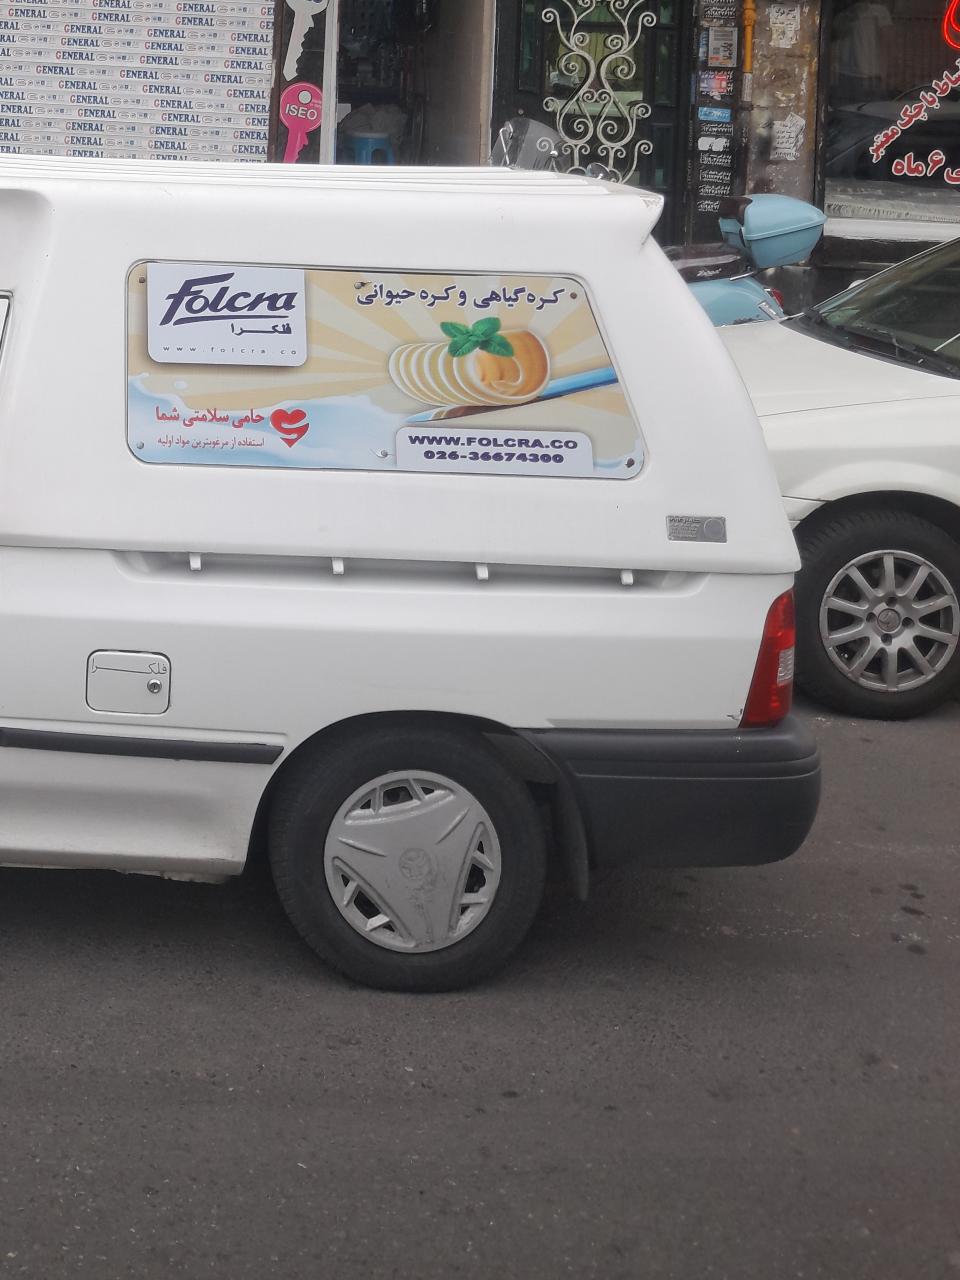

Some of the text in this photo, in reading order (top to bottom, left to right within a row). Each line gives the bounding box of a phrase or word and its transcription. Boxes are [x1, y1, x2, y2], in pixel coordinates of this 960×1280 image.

[176, 2, 215, 13] GENERAL
[175, 16, 214, 27] GENERAL
[204, 73, 243, 84] GENERAL
[142, 84, 181, 95] GENERAL
[70, 94, 109, 105] GENERAL
[161, 112, 200, 123] GENERAL
[285, 103, 318, 120] ISEO
[65, 121, 104, 132] GENERAL
[64, 135, 103, 146] GENERAL
[892, 152, 925, 176] ماه
[159, 272, 297, 326] Folcra
[357, 283, 565, 310] کره گیاهی و کره حیوانی
[231, 323, 292, 336] فلکرا
[155, 406, 265, 429] حامی سلامتی شما
[158, 435, 174, 448] اولیه
[176, 436, 190, 447] مواد
[230, 436, 237, 450] از
[238, 437, 265, 447] استفاده
[408, 435, 578, 450] WWW.FOLCRA.CO
[424, 450, 565, 464] 026-36674300
